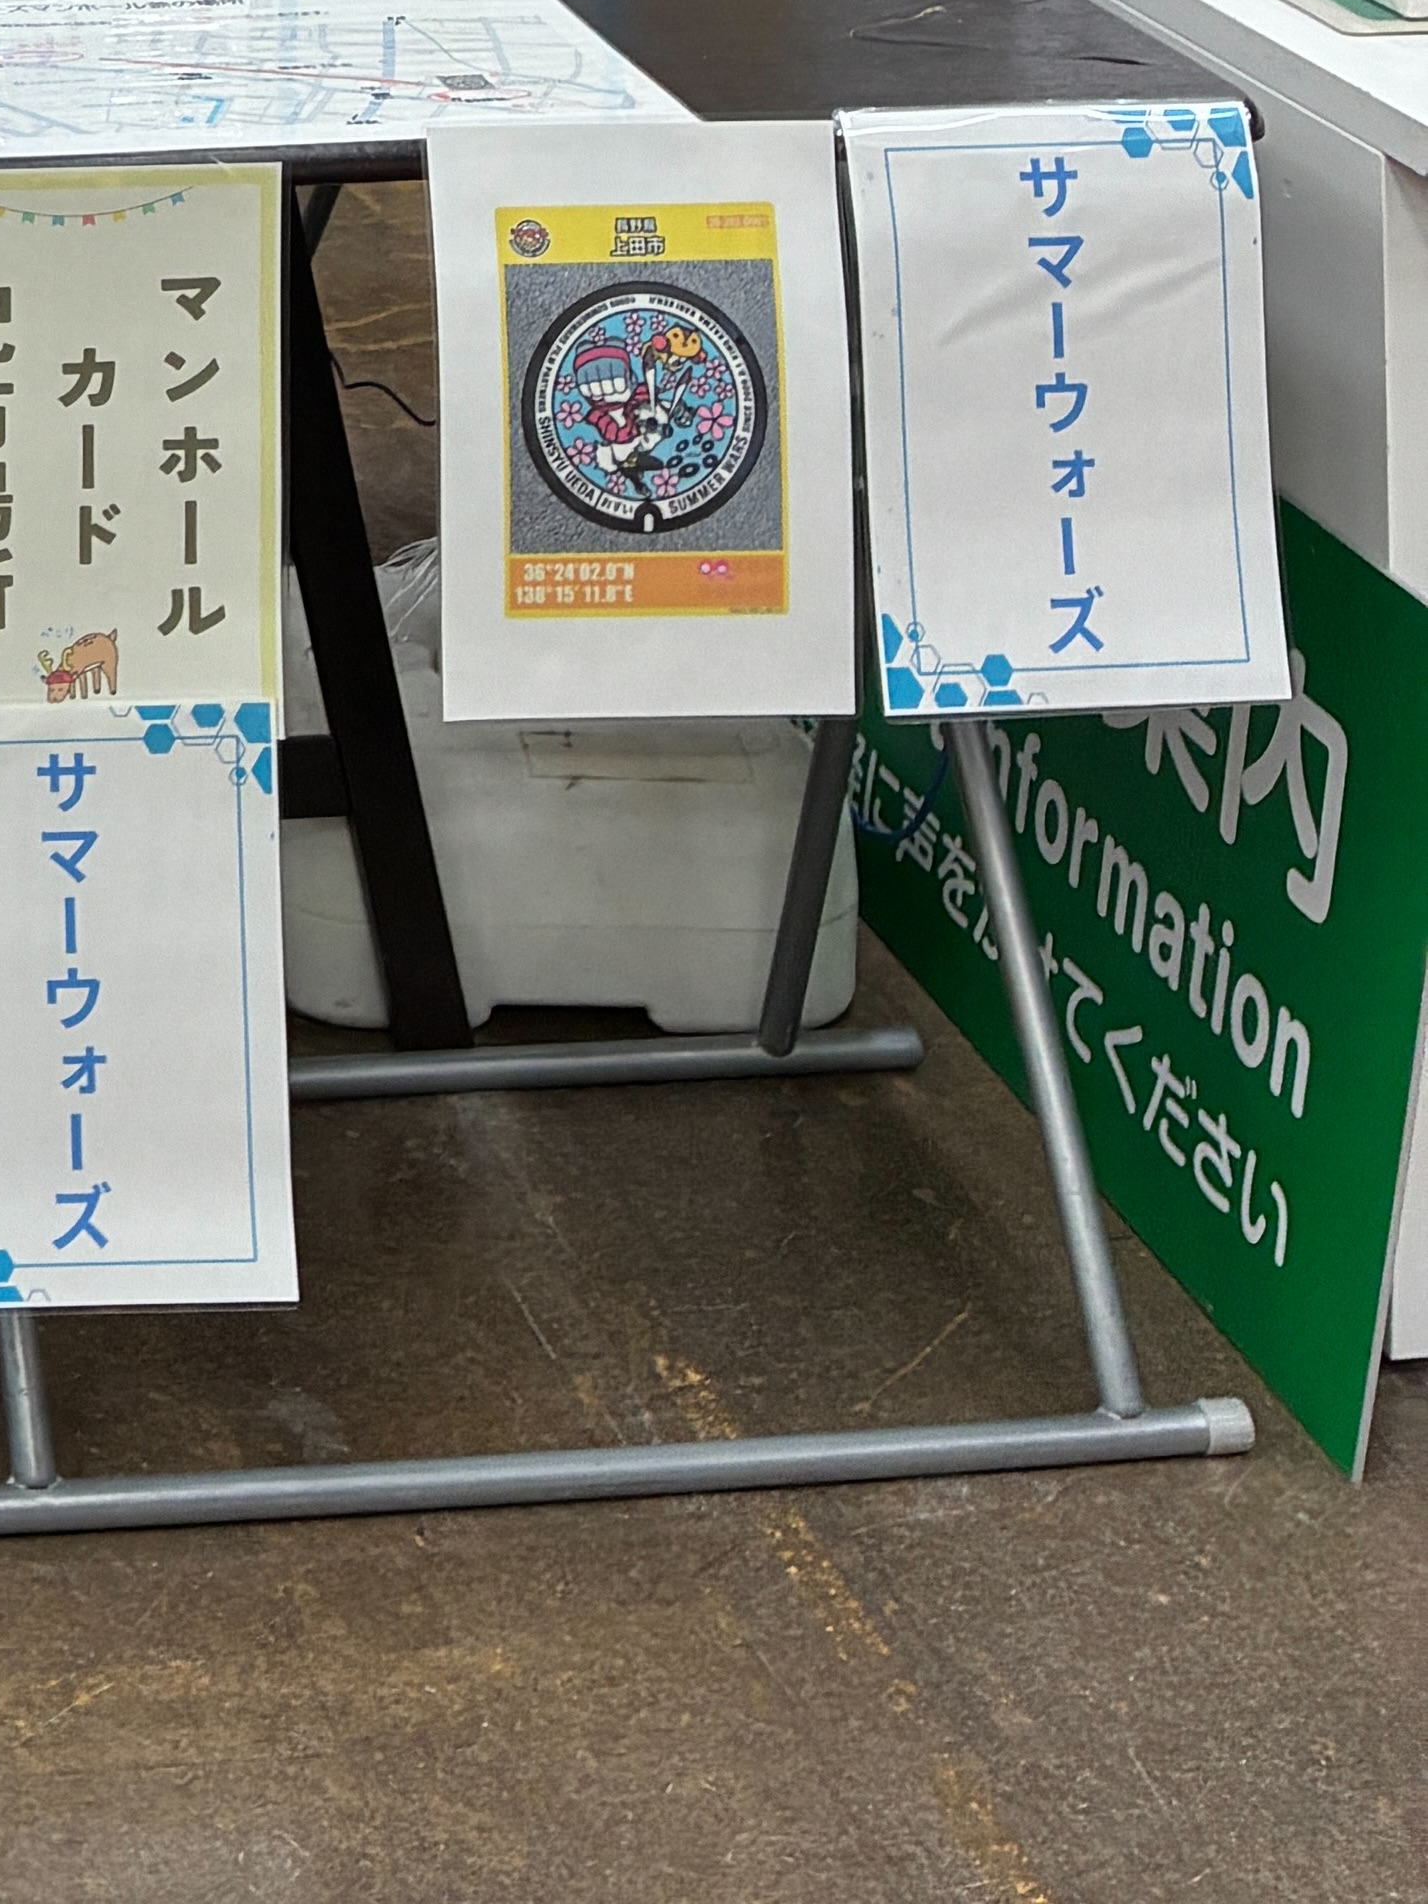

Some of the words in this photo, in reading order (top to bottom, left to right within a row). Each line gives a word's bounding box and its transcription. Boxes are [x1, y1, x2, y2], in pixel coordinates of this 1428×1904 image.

[610, 235, 665, 257] 上田市
[56, 346, 121, 569] カード
[156, 274, 228, 640] マンホール
[538, 415, 568, 474] SHINSYU
[565, 468, 596, 502] UEDA
[668, 473, 728, 514] SUMMER
[725, 433, 749, 475] WARS
[1019, 156, 1106, 655] サマーウォーズ
[36, 751, 112, 1253] サマーウォーズ
[931, 719, 1311, 1118] nformation
